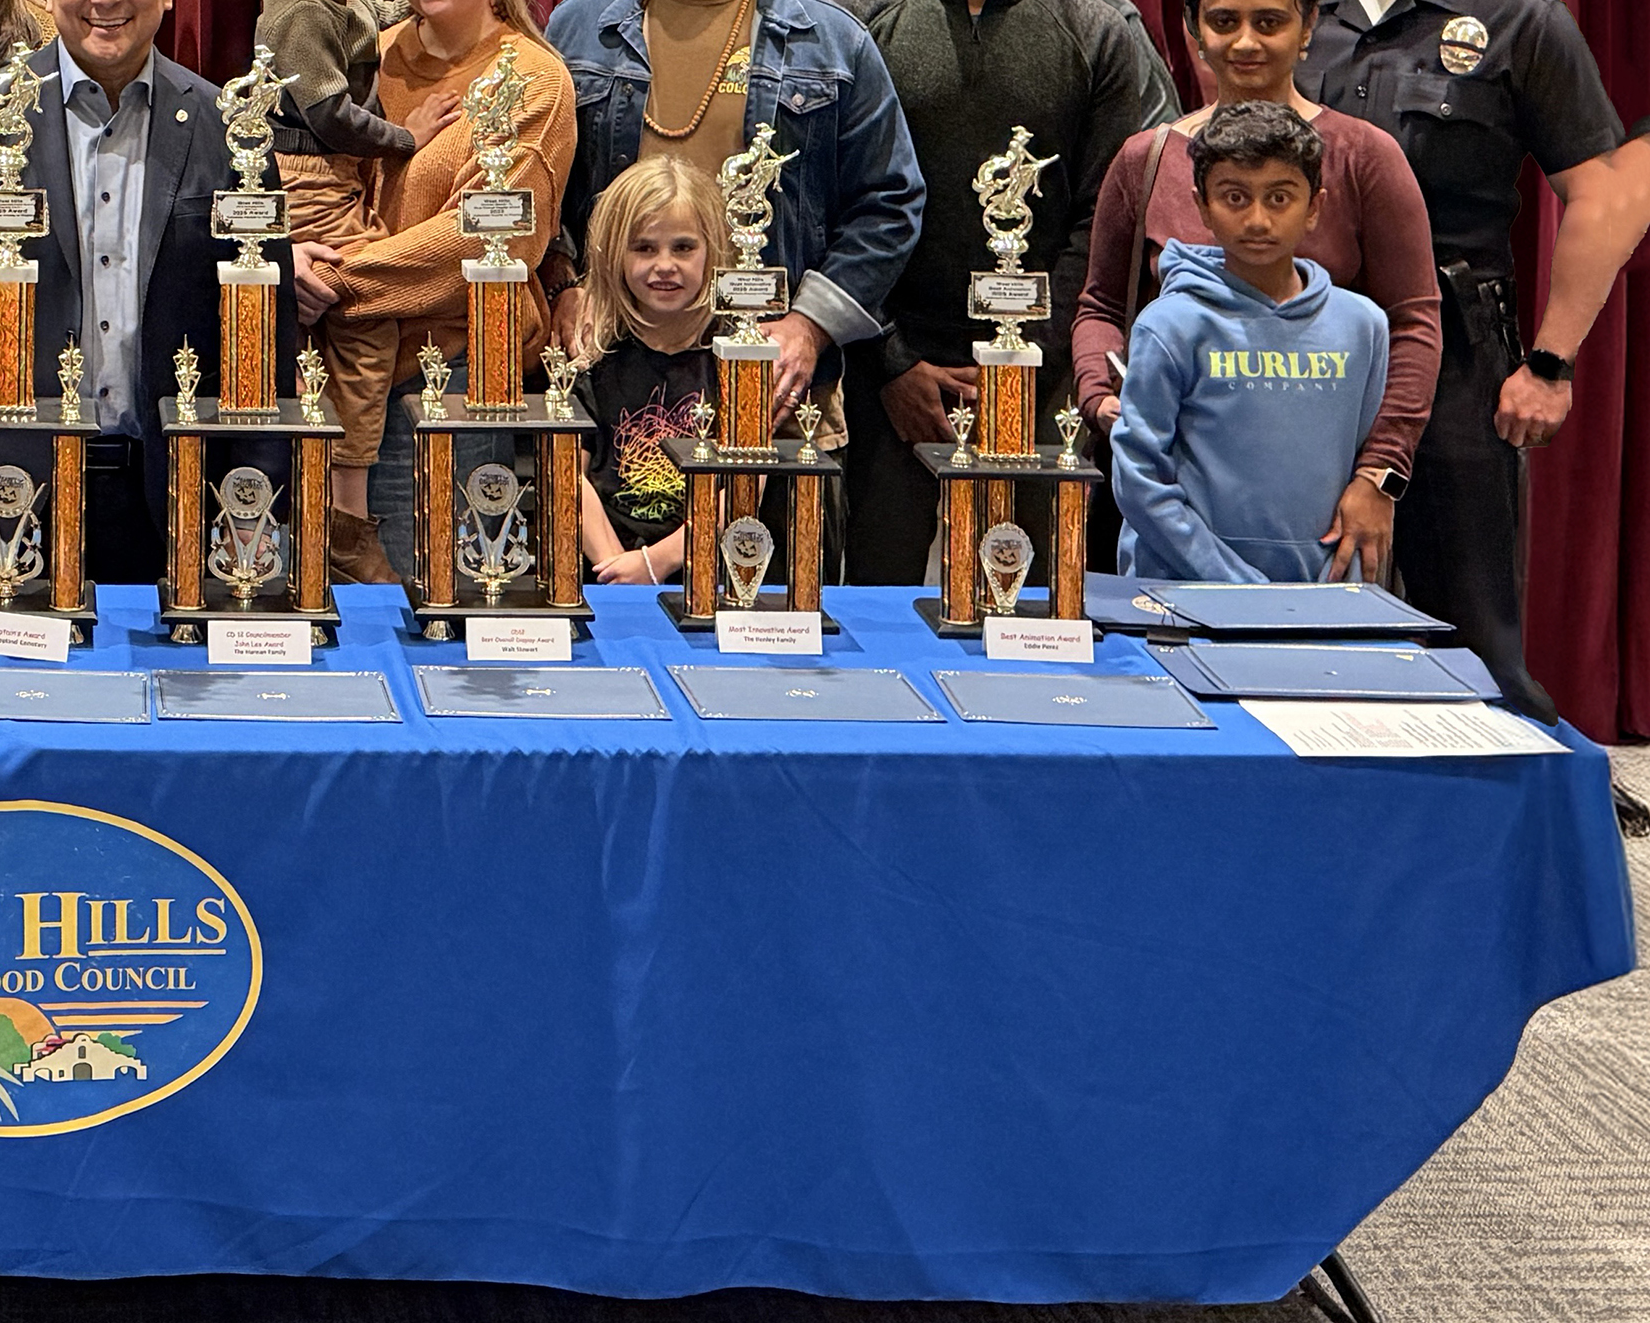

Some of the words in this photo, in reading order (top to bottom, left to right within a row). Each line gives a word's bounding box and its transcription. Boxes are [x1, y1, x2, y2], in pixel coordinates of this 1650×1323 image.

[1209, 350, 1350, 379] HURLEY
[1228, 381, 1337, 391] COMPANY
[23, 631, 46, 639] Award
[787, 626, 810, 634] Award
[1000, 632, 1017, 640] Best
[1019, 634, 1056, 642] Animation
